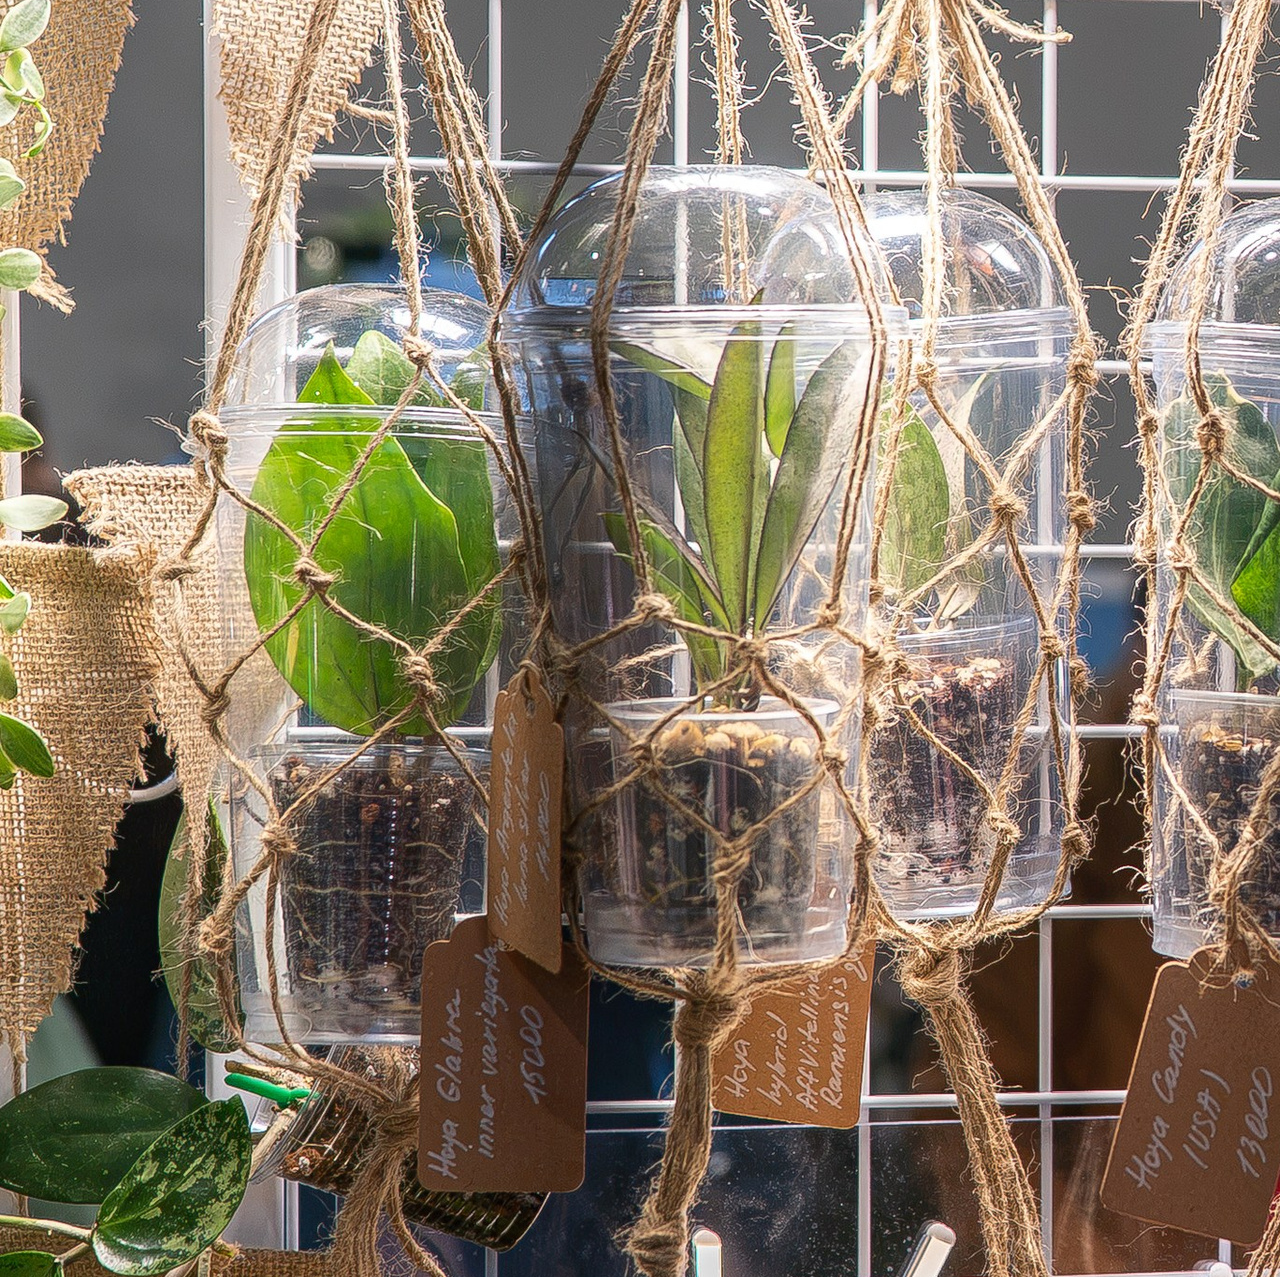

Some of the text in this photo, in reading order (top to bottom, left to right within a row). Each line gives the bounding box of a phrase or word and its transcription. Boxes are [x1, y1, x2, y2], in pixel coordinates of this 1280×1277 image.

[519, 1003, 548, 1105] 15000
[723, 1038, 757, 1098] Hoya
[756, 1011, 793, 1106] hybrid
[1125, 1004, 1198, 1191] Hoya Candy
[427, 1118, 469, 1180] Hoya
[1236, 1066, 1274, 1178] 13000
